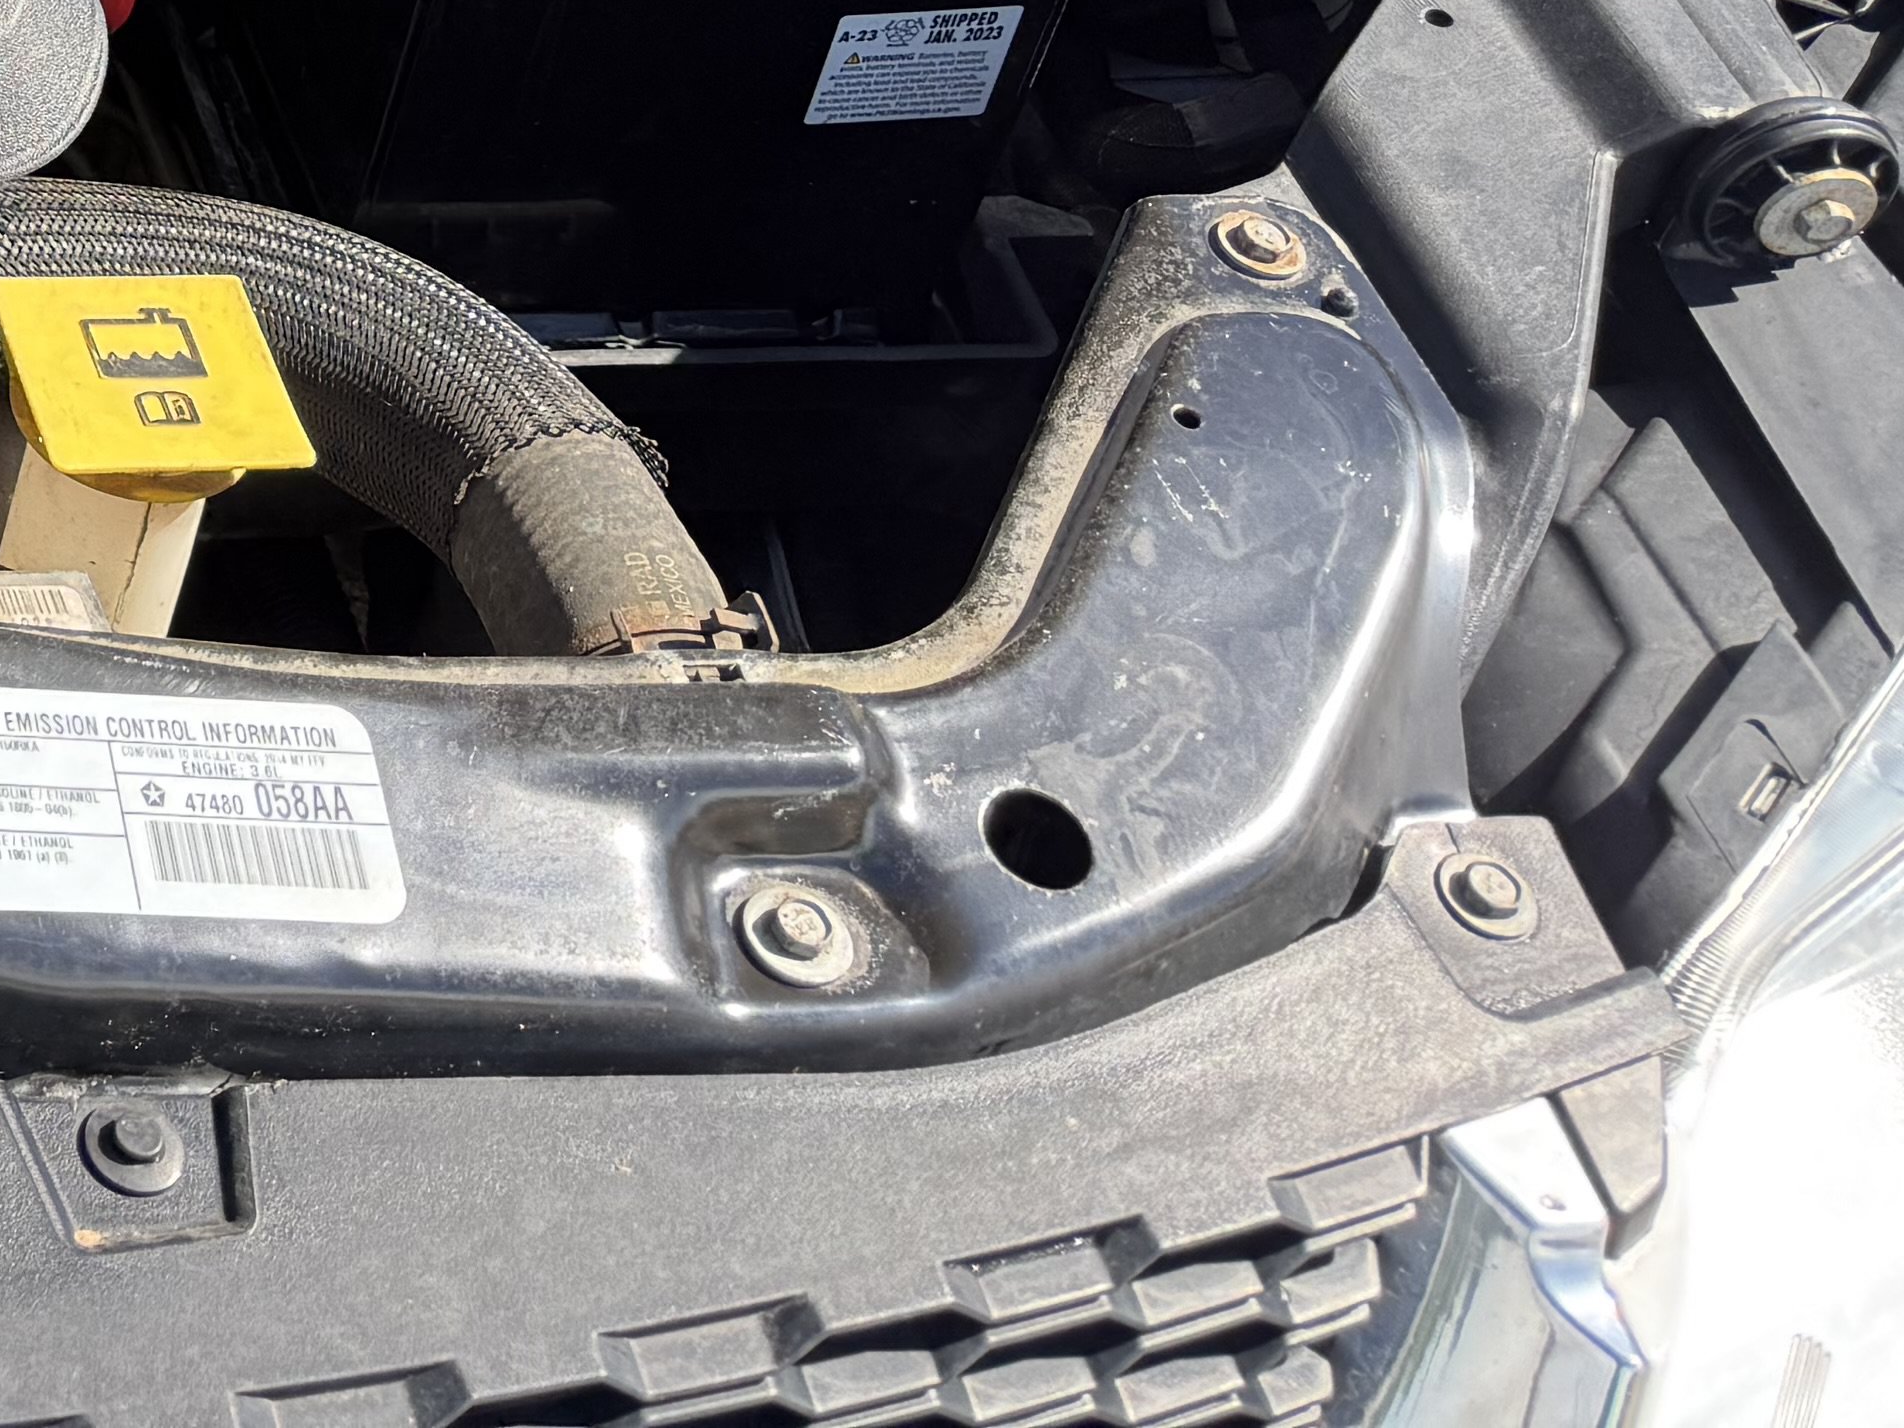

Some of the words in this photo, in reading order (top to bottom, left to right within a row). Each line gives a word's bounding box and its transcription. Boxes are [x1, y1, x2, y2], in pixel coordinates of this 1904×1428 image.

[930, 12, 998, 29] SHIPPED
[838, 29, 878, 43] A-23
[924, 29, 957, 44] JAN.
[962, 26, 1004, 41] 2023
[862, 53, 915, 63] WARNING
[4, 710, 99, 736] EMISSION
[106, 716, 196, 742] CONTROL
[202, 721, 337, 748] INFORMATION
[185, 794, 244, 816] 47480
[254, 783, 355, 821] 058AA
